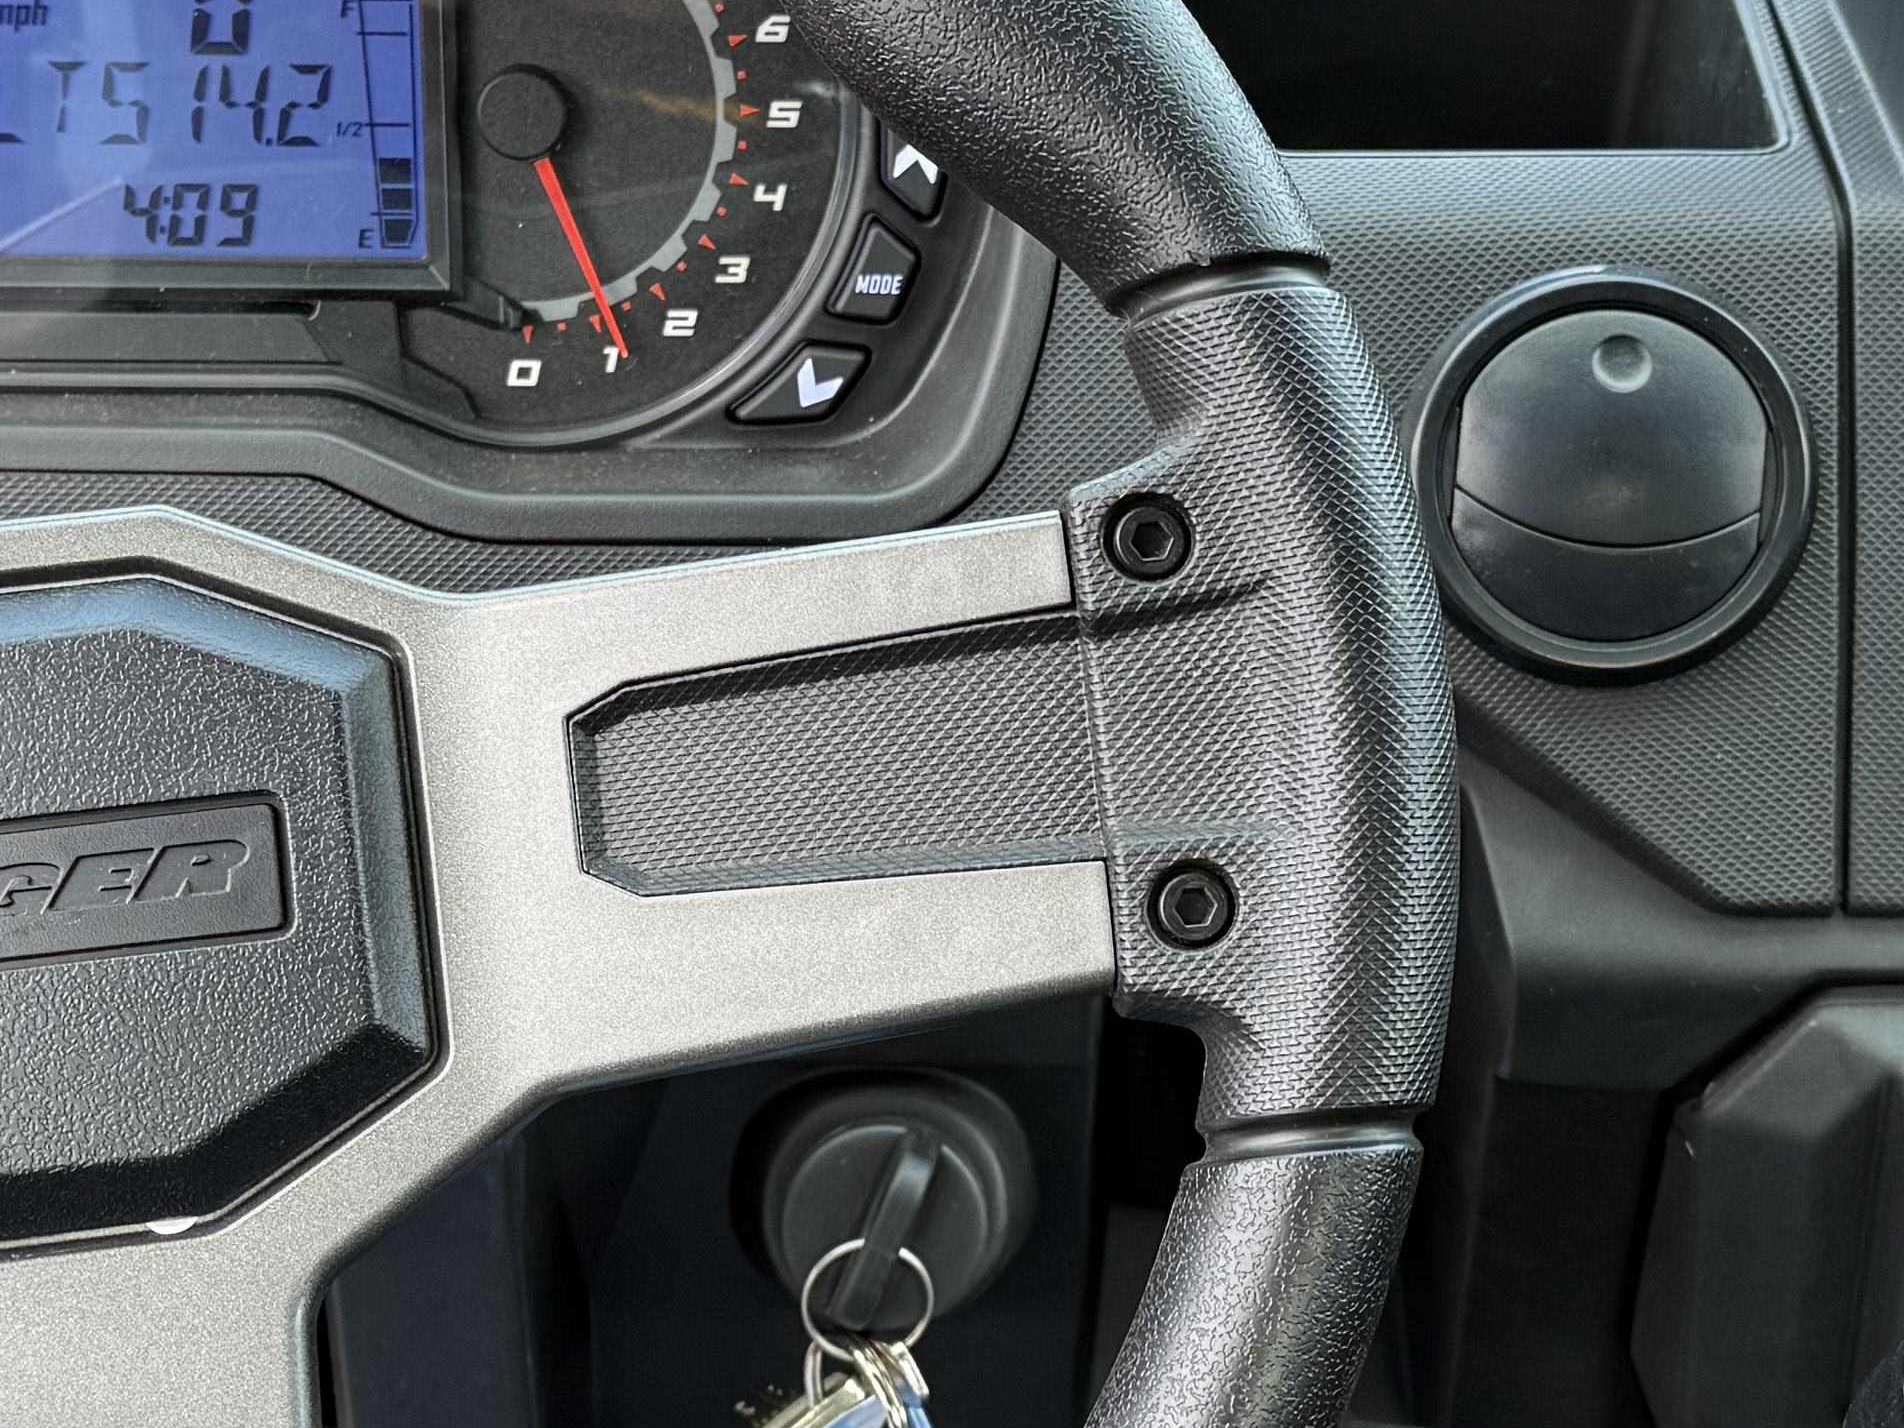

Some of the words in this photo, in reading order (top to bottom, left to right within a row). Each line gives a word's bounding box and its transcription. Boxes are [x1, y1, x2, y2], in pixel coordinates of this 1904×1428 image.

[341, 0, 356, 18] F
[755, 15, 791, 43] 6
[766, 100, 803, 128] 5
[336, 120, 364, 138] 1/2
[753, 183, 788, 212] 4
[123, 183, 259, 247] 4:09
[358, 228, 374, 249] E
[715, 256, 751, 284] 3
[855, 273, 904, 295] MODE
[662, 309, 698, 337] 2
[506, 359, 542, 387] 0
[602, 346, 619, 373] 1
